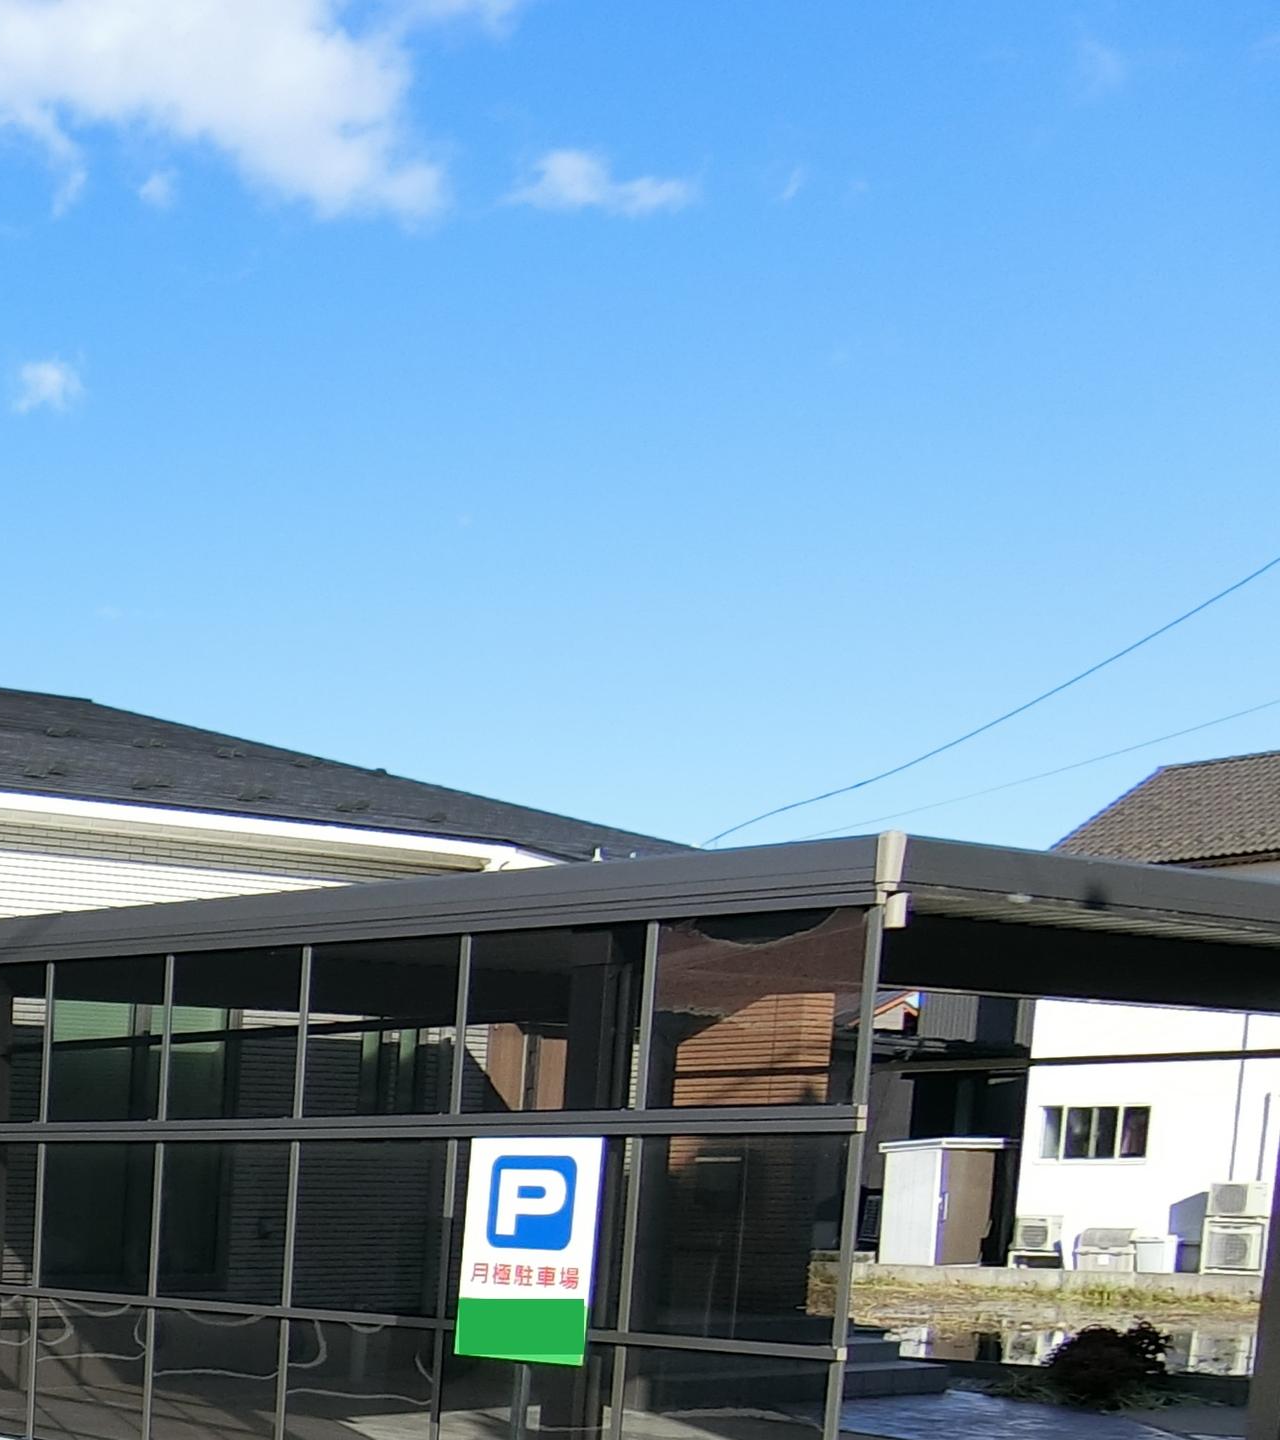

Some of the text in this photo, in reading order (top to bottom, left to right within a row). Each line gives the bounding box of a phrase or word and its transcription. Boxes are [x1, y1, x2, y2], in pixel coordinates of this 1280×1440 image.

[495, 1168, 567, 1236] P
[471, 1262, 580, 1290] 月極駐車場
